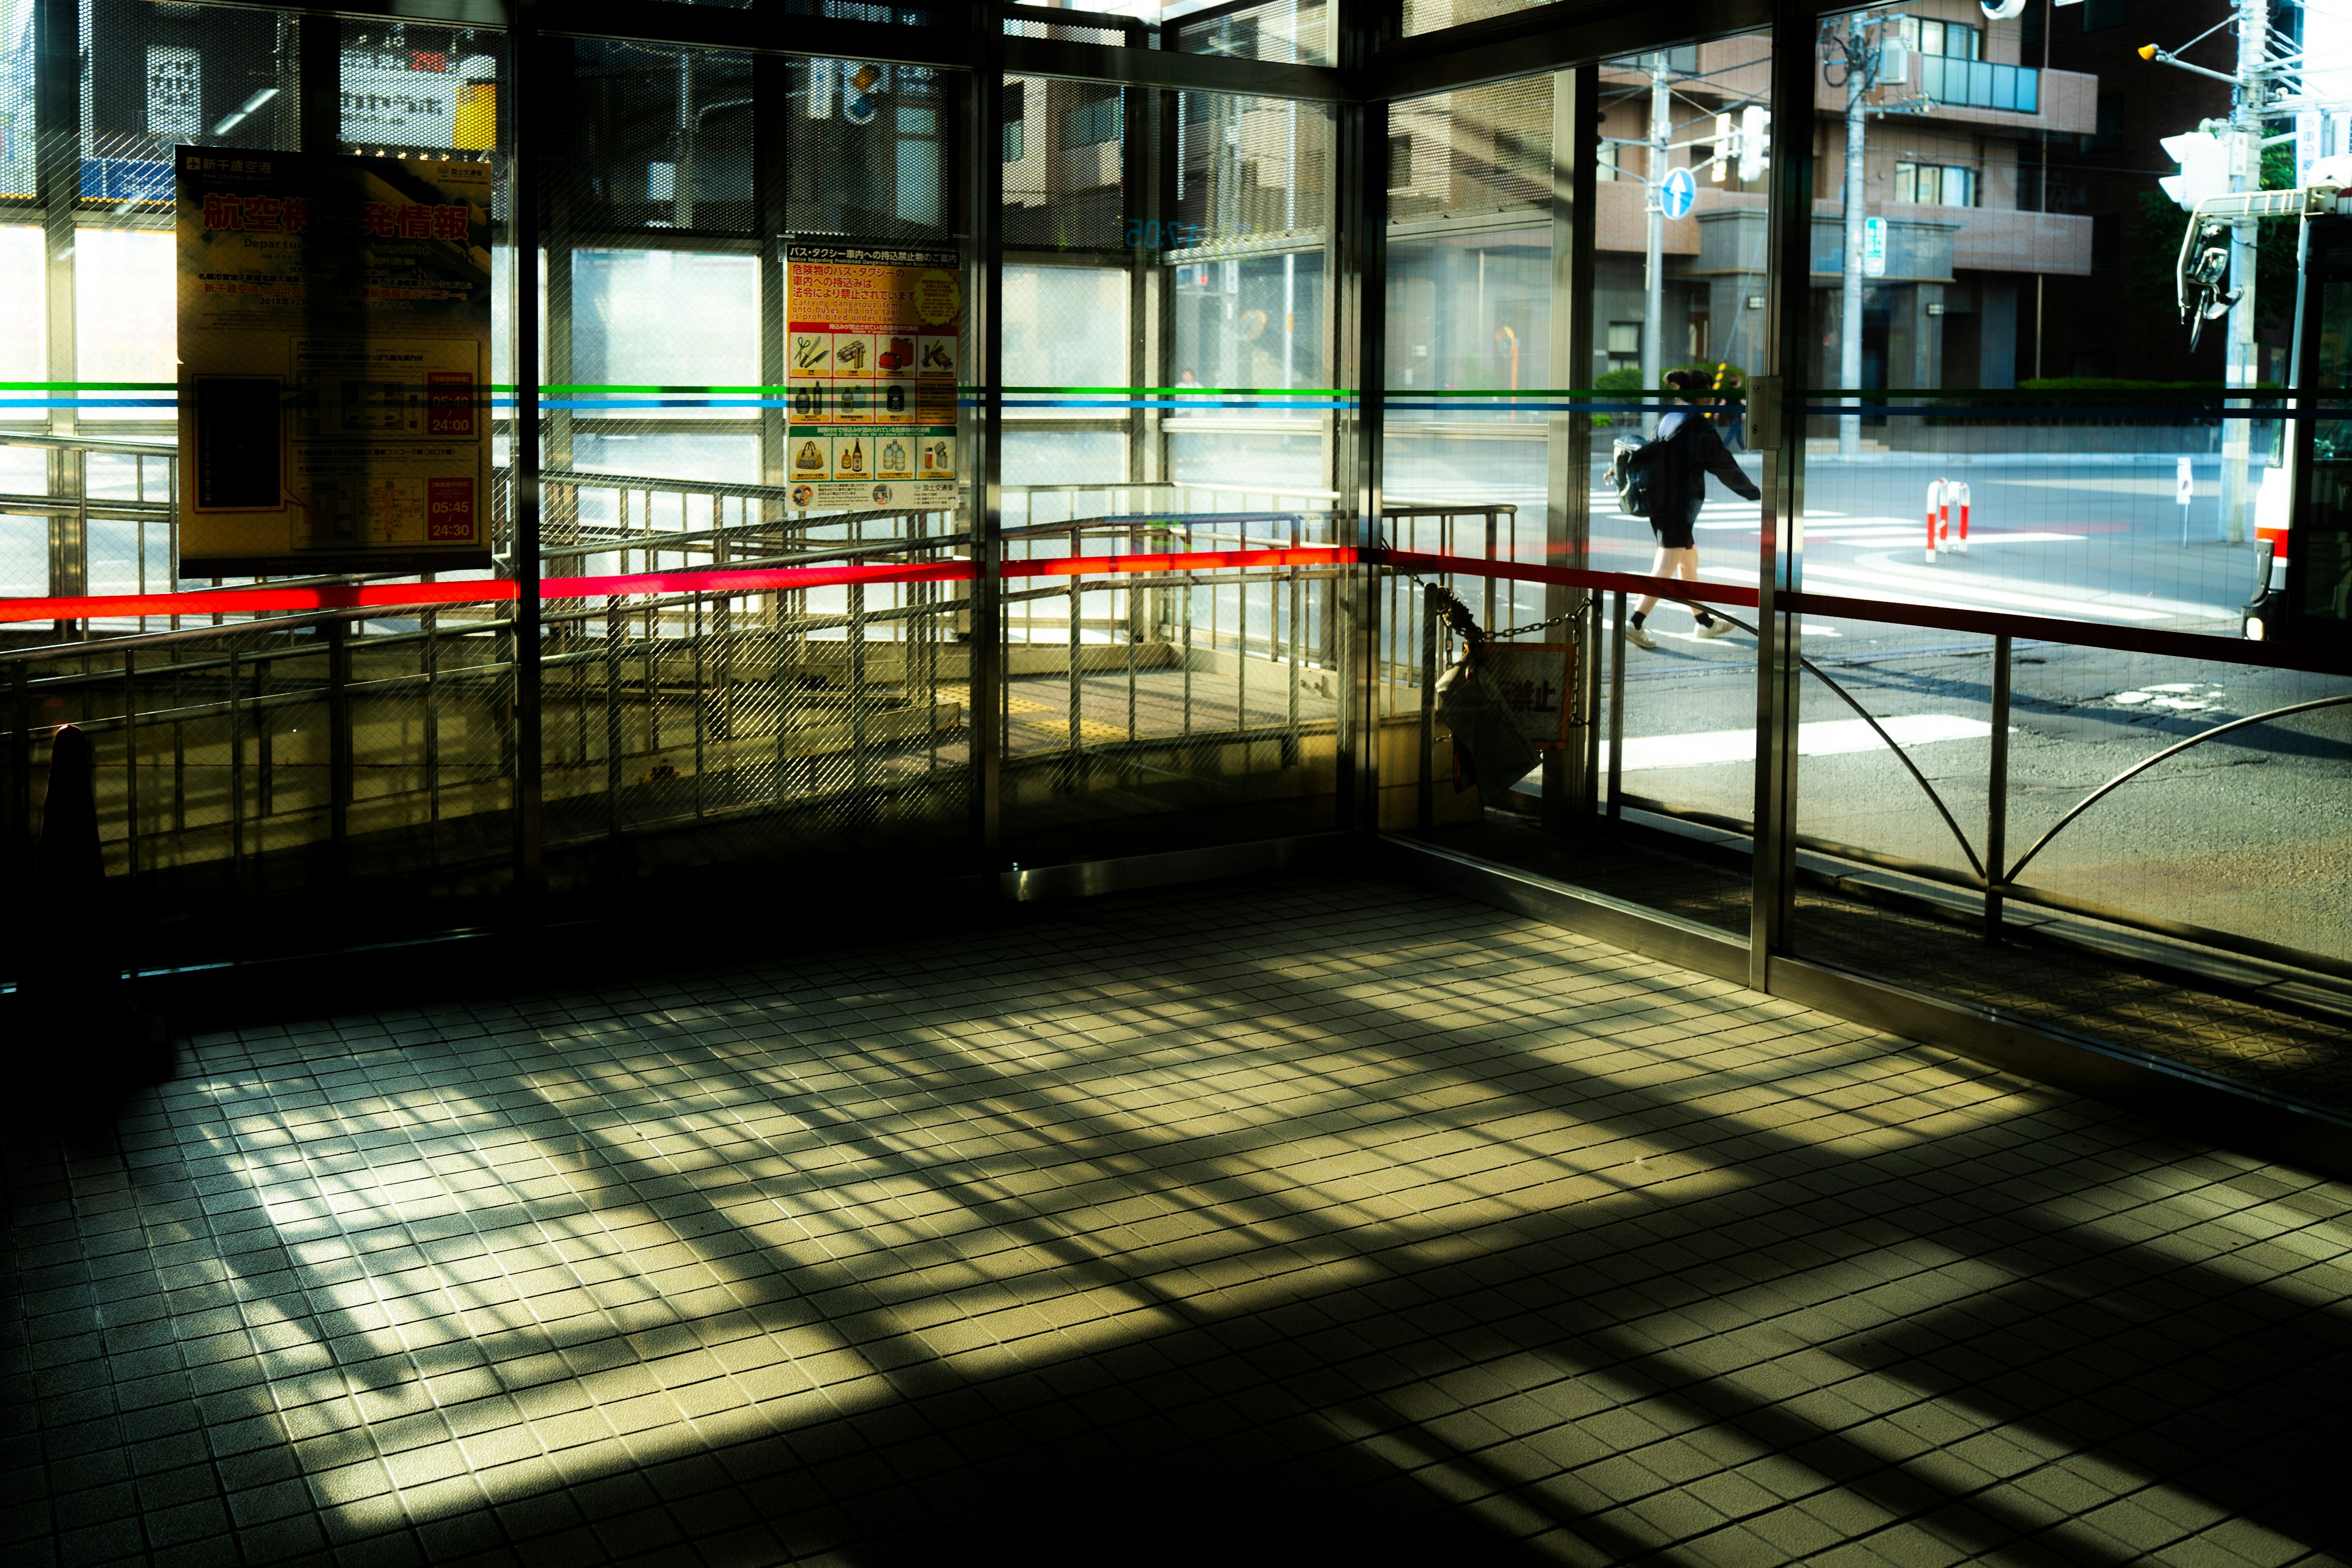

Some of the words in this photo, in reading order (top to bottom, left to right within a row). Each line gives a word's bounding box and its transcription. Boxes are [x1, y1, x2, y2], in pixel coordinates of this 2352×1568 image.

[2303, 117, 2315, 185] 歩車分離
[203, 159, 272, 174] 新千歳空港
[202, 192, 470, 240] 航空機出発情報
[244, 238, 311, 251] Departure
[790, 247, 957, 263] バス・タクシー車内への持込禁止物のご案内
[793, 264, 904, 279] 危険物のバス・タクシーの
[793, 276, 876, 288] 車内への持込みは、
[793, 287, 919, 302] 法令により禁止されています。
[793, 299, 829, 308] Carrying
[833, 300, 876, 309] dangerous
[432, 396, 469, 408] 05:40
[432, 419, 469, 431] 24:00
[432, 501, 469, 513] 05:45
[432, 524, 469, 537] 24:30
